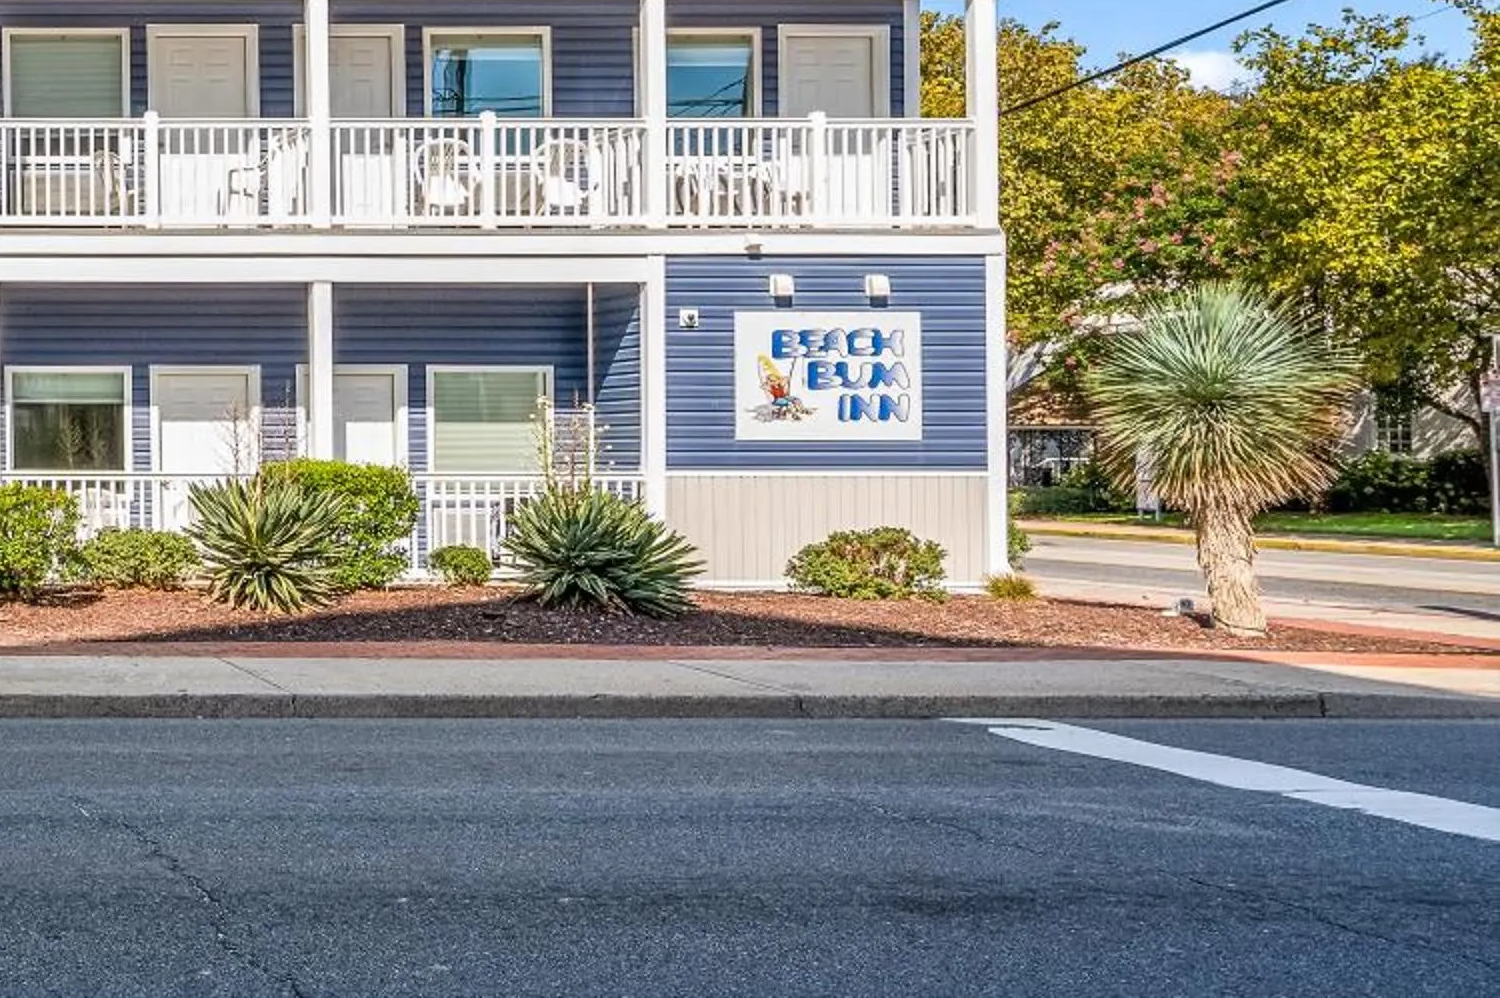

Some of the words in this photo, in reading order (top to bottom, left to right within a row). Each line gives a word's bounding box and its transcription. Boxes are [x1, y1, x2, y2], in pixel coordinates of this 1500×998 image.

[771, 327, 905, 359] BEACH
[807, 360, 911, 391] BUM
[838, 393, 911, 423] INN
